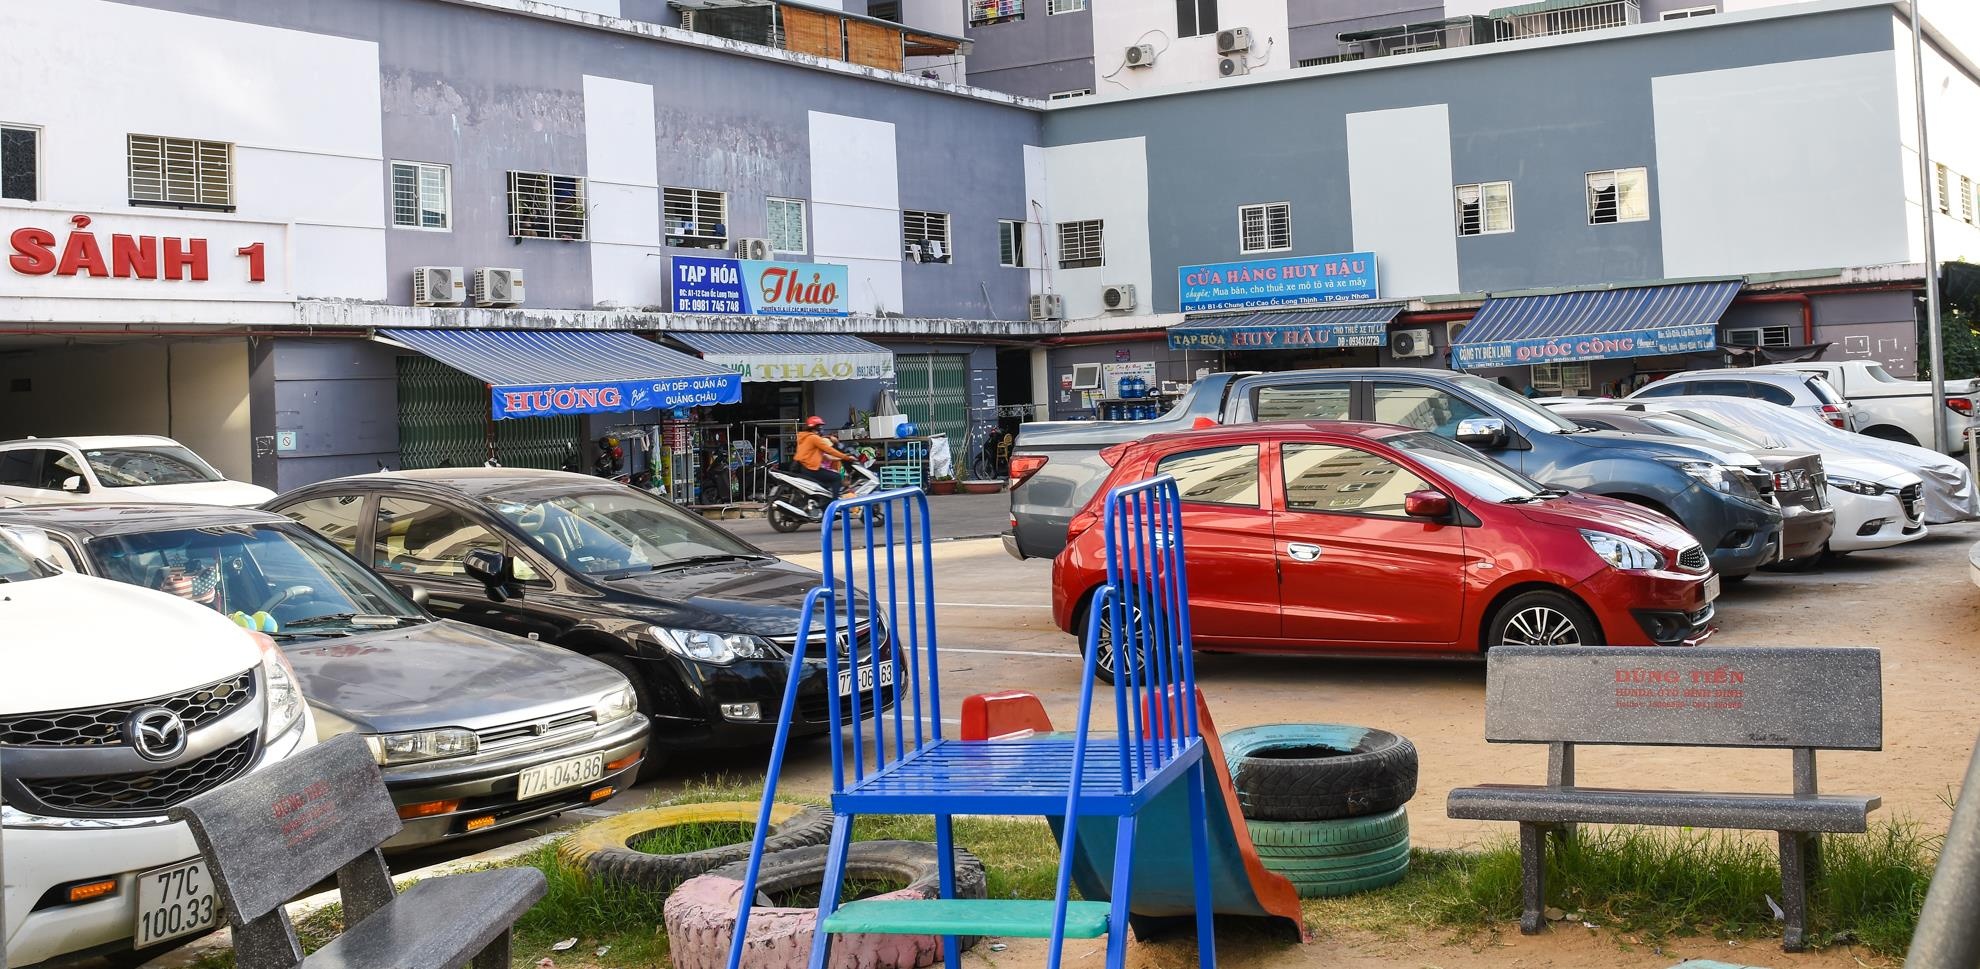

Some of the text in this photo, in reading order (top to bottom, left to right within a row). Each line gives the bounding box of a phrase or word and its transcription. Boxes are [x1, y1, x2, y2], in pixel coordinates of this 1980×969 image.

[9, 214, 265, 282] SẢNH 1
[679, 264, 738, 285] TẠP HÓA
[1187, 258, 1365, 286] CỬA HÀNG HUY HẬU
[760, 266, 838, 305] Thảo
[1212, 287, 1230, 297] Mua
[1250, 284, 1265, 293] cho
[1267, 282, 1284, 292] thuê
[1286, 283, 1296, 291] xe
[1298, 281, 1311, 290] mô
[1314, 279, 1322, 289] tô
[1324, 279, 1334, 288] và
[1337, 280, 1347, 288] xe
[1349, 277, 1367, 288] máy
[691, 299, 709, 312] 0981
[711, 300, 725, 312] 745
[726, 300, 739, 313] 748
[1224, 301, 1244, 309] Chung
[1281, 297, 1298, 306] Long
[1299, 296, 1318, 305] Thịnh
[1173, 335, 1198, 345] TẠP
[1231, 331, 1277, 346] HUY
[1283, 327, 1330, 347] HẬU
[1516, 338, 1572, 361] QUỐC
[1576, 336, 1634, 354] CÔNG
[652, 381, 672, 393] GIÀY
[672, 380, 689, 391] DÉP
[716, 378, 728, 388] ÁO
[504, 386, 622, 412] HƯƠNG
[665, 391, 717, 404] QUẢNG CHÂU
[1615, 664, 1744, 684] DŨNG TIẾN
[522, 756, 601, 795] 77A-043.86
[158, 866, 199, 904] 77C
[142, 894, 213, 942] 100.33
